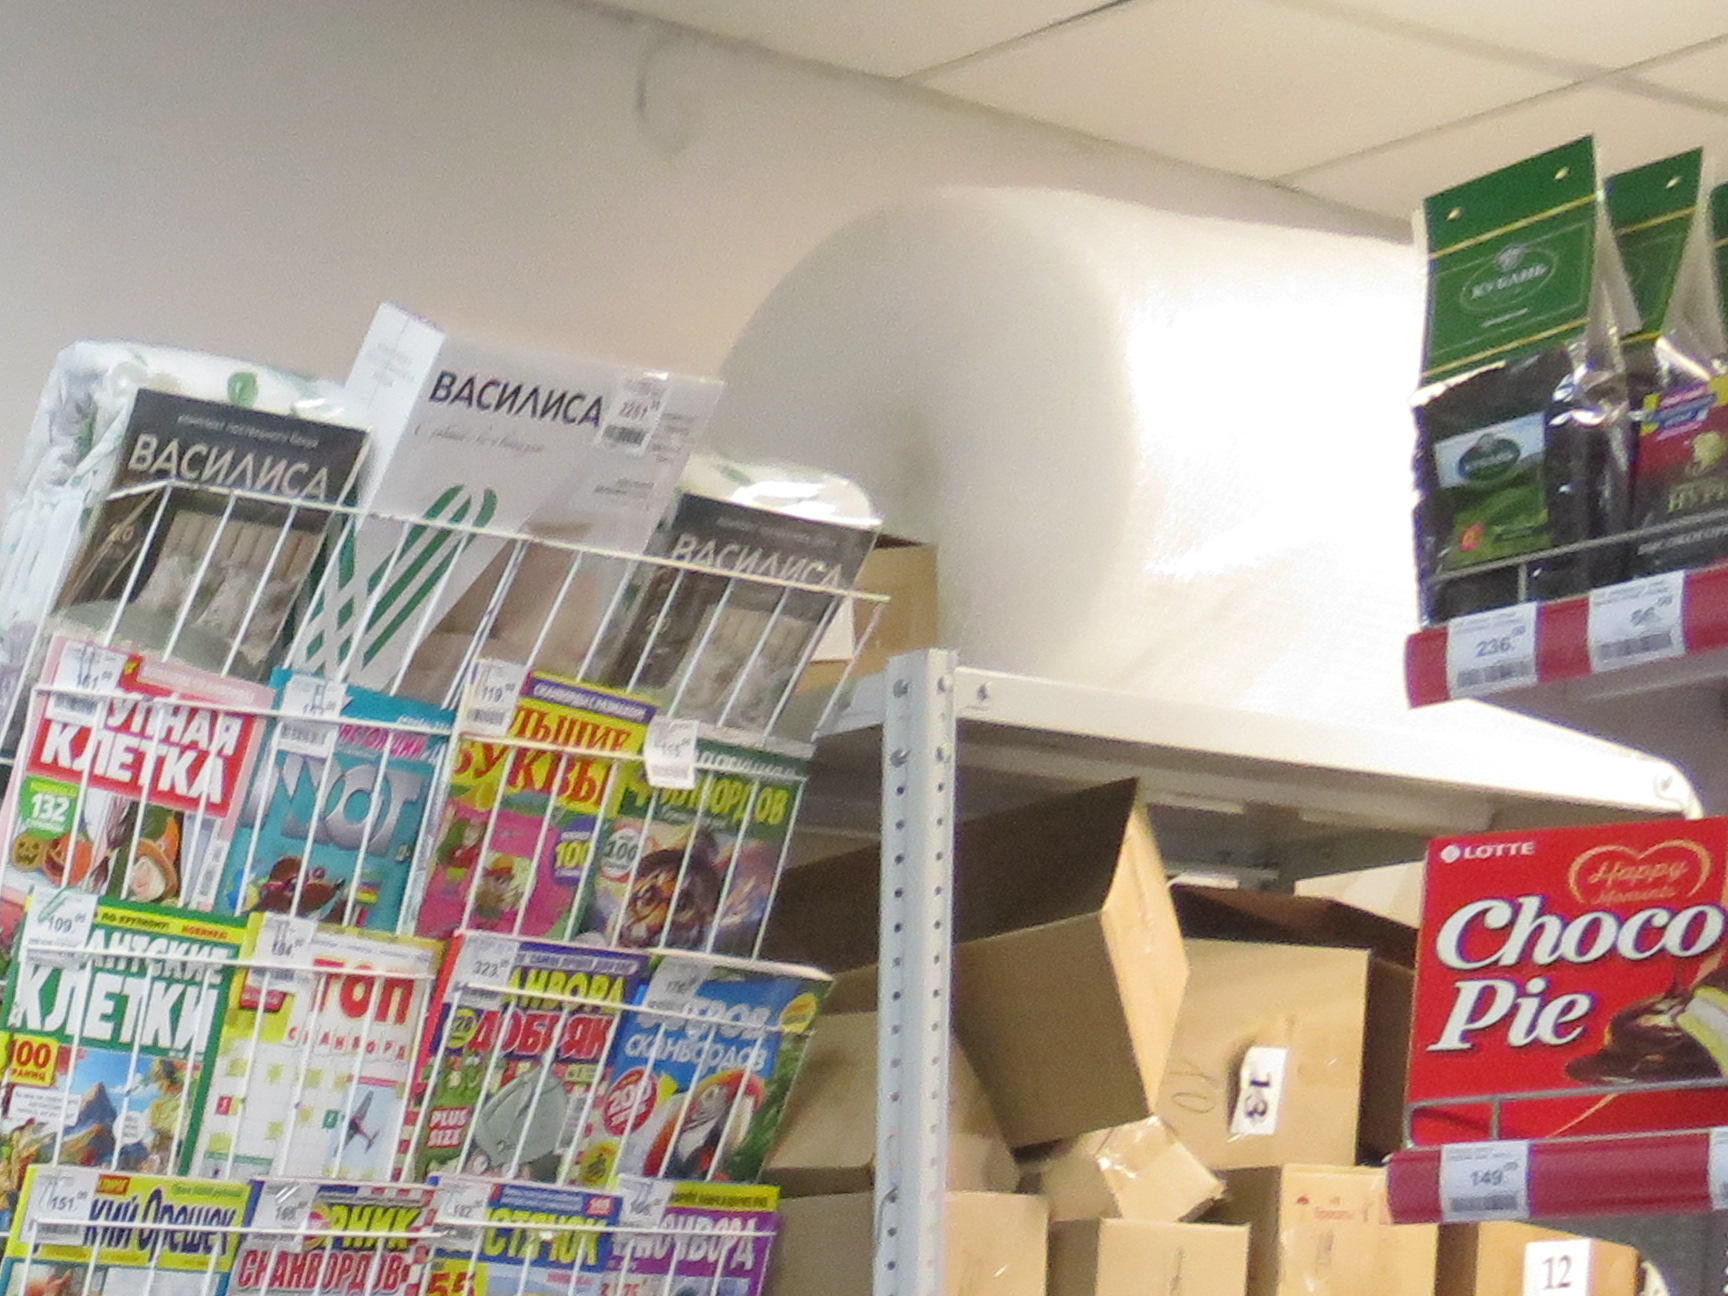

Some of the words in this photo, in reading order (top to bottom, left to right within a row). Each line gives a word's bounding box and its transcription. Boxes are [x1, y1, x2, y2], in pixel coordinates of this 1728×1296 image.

[428, 372, 606, 430] ВАСИЛИСА
[127, 433, 332, 502] ВАСИЛИСА
[668, 533, 844, 592] ВАСИЛИСА
[39, 717, 225, 804] КЛЕТКА
[29, 792, 71, 821] 132
[1463, 841, 1535, 861] LOTTE
[1588, 860, 1690, 887] Happy
[1435, 895, 1725, 971] Choco
[7, 962, 220, 1056] КЛЕТКИ
[312, 957, 416, 1026] ТОП
[1426, 977, 1593, 1053] Pie
[9, 1039, 52, 1068] 100
[427, 1127, 466, 1149] SIZE
[429, 1108, 472, 1127] PLUS
[137, 1186, 237, 1262] Орешек
[236, 1248, 410, 1296] СКАНВОРДОВ
[1542, 1254, 1573, 1291] 12
